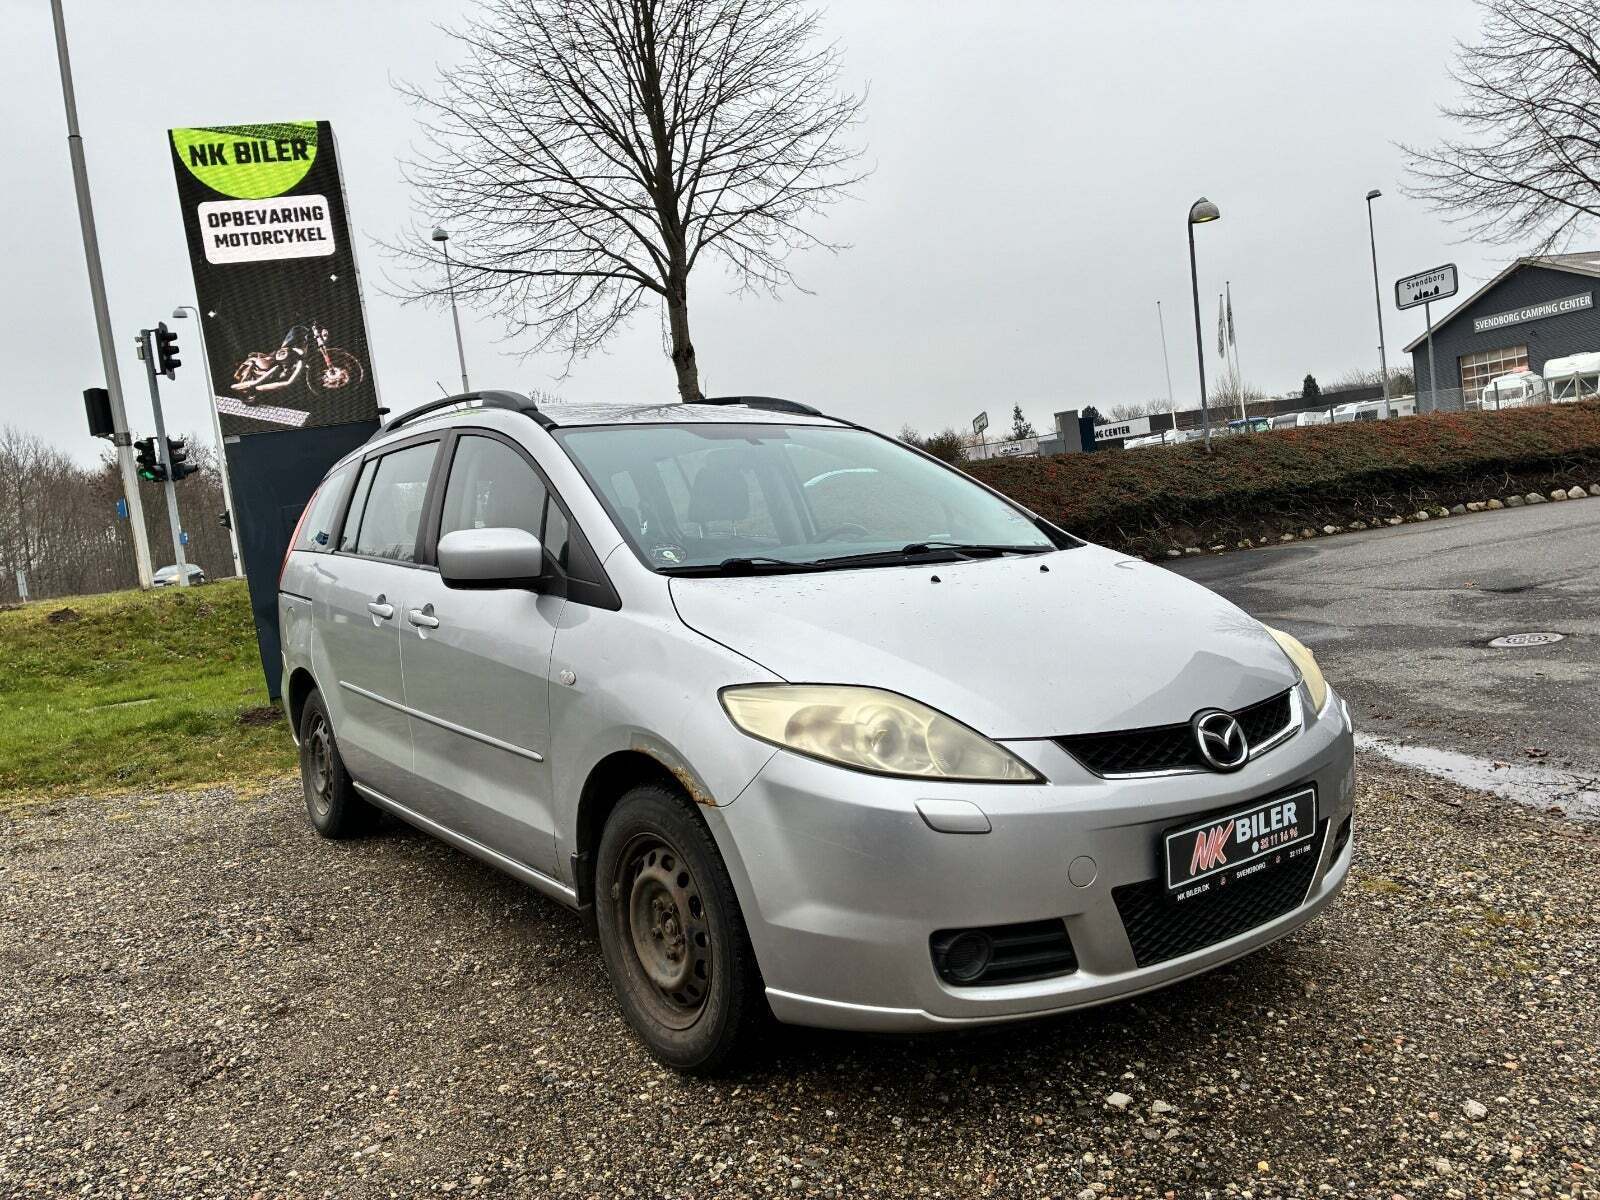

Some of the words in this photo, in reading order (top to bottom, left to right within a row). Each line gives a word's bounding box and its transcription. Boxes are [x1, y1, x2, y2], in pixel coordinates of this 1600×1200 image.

[188, 143, 228, 167] NK
[233, 138, 310, 164] BILER
[207, 205, 324, 228] OPBEVARING
[214, 227, 326, 248] MOTORCYKEL
[1406, 273, 1445, 290] Svendborg
[1475, 312, 1519, 331] SVENDBORG
[1521, 304, 1558, 320] CAMPING
[1560, 295, 1591, 310] CENTER
[1104, 426, 1130, 437] CENTER
[1190, 819, 1235, 875] NK
[1236, 802, 1298, 843] BILER
[1270, 833, 1278, 845] 11
[1280, 830, 1289, 842] 16
[1236, 861, 1266, 879] SVENDBORG
[1177, 892, 1186, 901] NK
